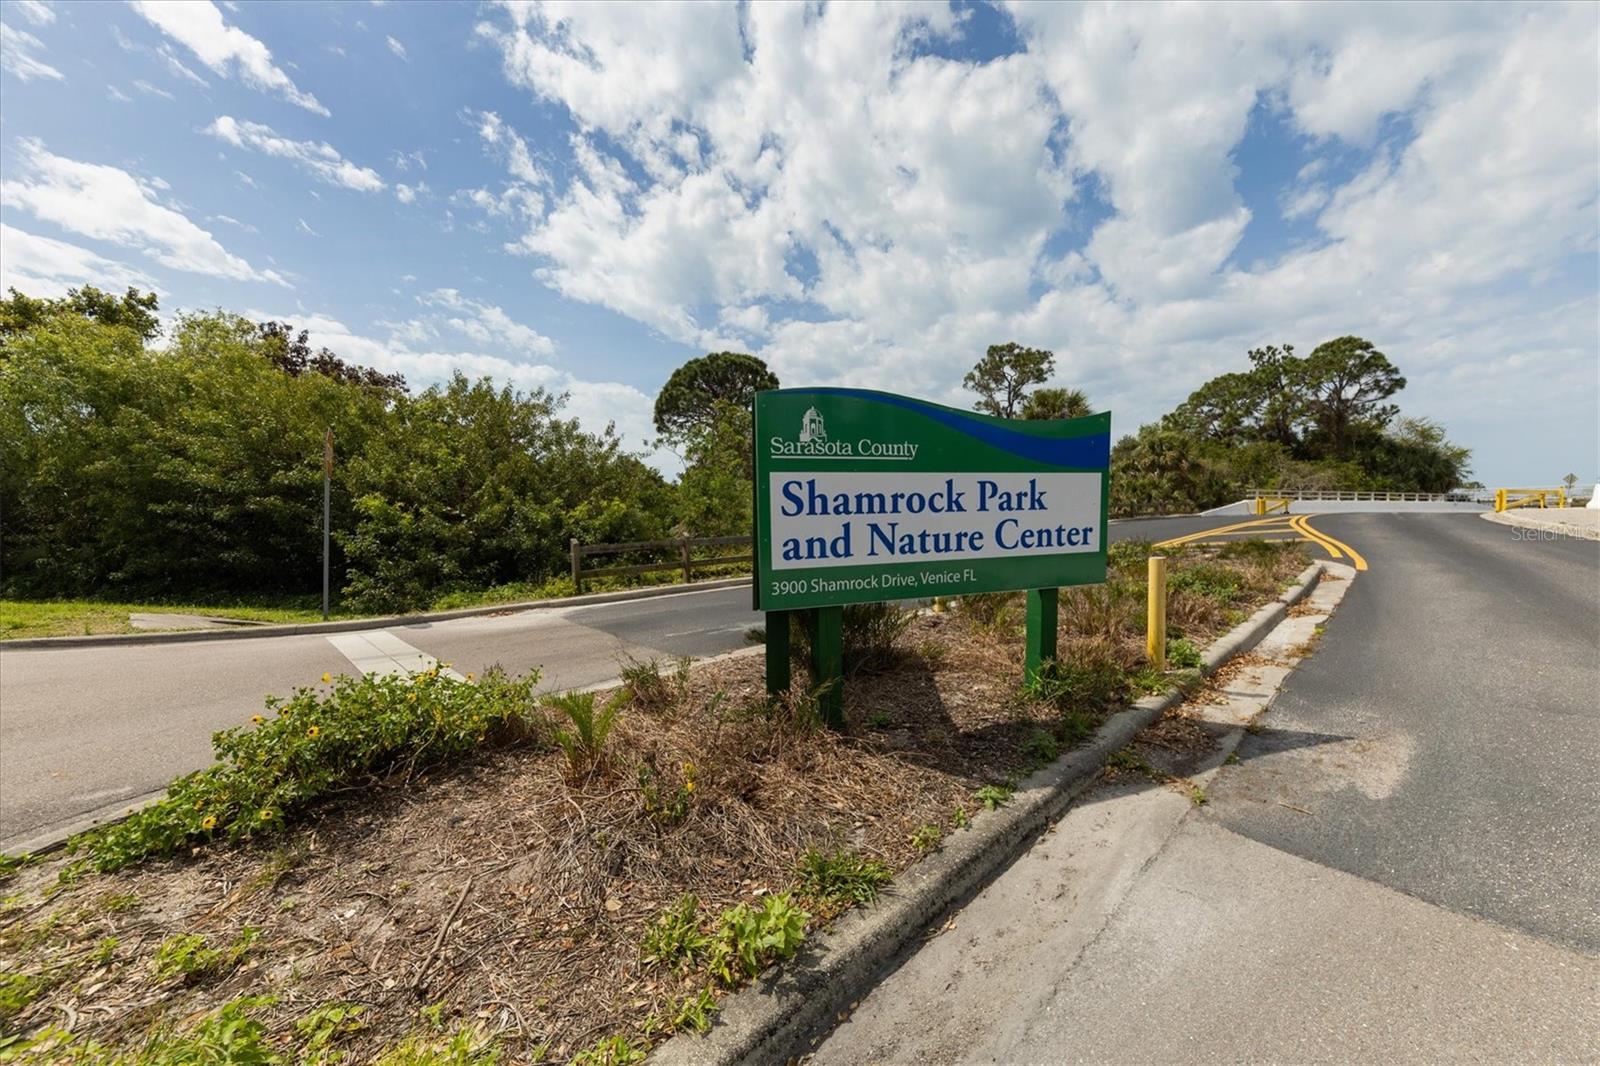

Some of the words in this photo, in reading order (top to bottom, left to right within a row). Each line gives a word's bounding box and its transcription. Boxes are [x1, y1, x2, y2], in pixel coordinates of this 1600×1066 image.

[770, 437, 853, 455] Sarasota
[858, 439, 919, 460] County
[781, 478, 967, 517] Shamrock
[976, 478, 1048, 512] Park
[782, 522, 854, 561] and
[867, 523, 984, 556] Nature
[994, 518, 1094, 550] Center
[771, 581, 807, 596] 3900
[811, 575, 879, 593] Shamrock
[882, 574, 918, 588] Drive,
[920, 571, 961, 584] Venice
[963, 568, 977, 582] FL
